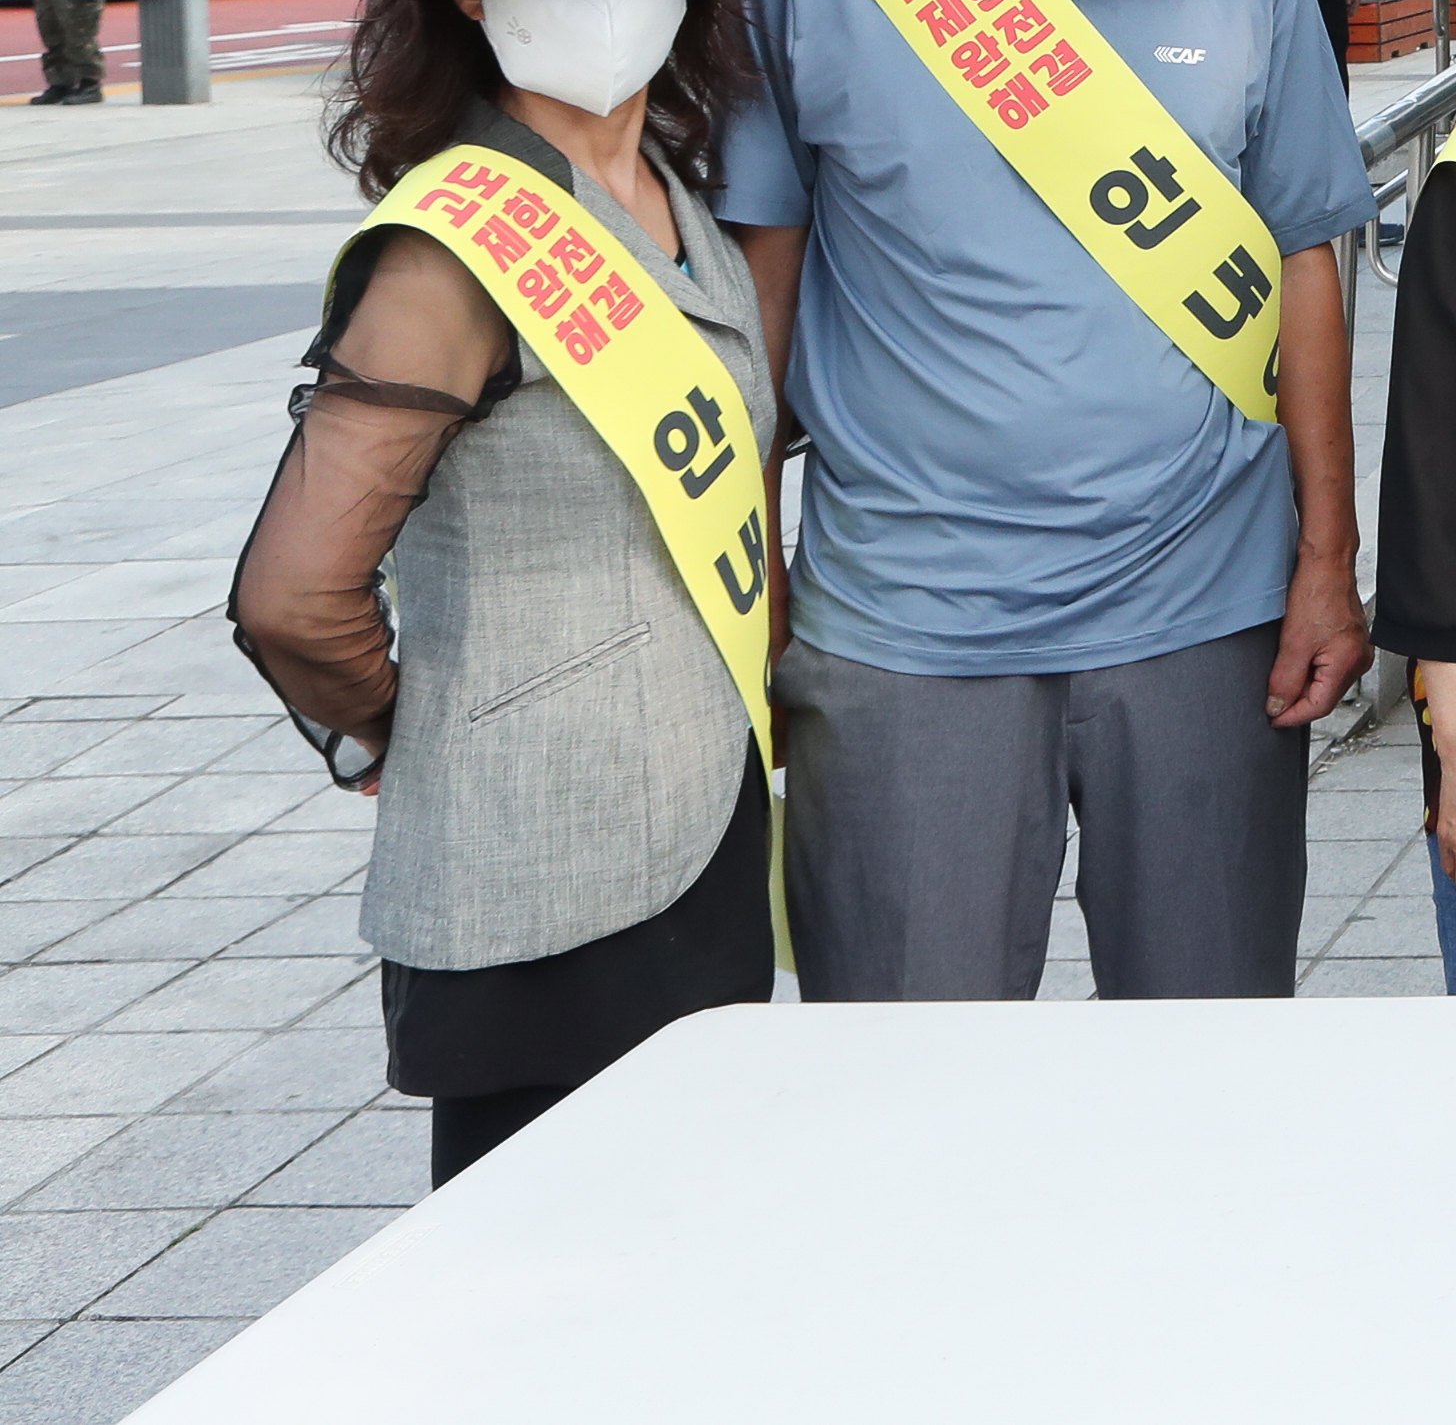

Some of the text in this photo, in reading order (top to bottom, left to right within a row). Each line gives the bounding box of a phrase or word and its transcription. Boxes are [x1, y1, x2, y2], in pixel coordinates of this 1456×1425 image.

[987, 39, 1093, 130] 해결
[415, 160, 510, 229] 고도
[470, 187, 560, 274] 제한
[516, 227, 605, 320] 완전
[1089, 146, 1279, 397] 안내
[555, 272, 645, 366] 해결
